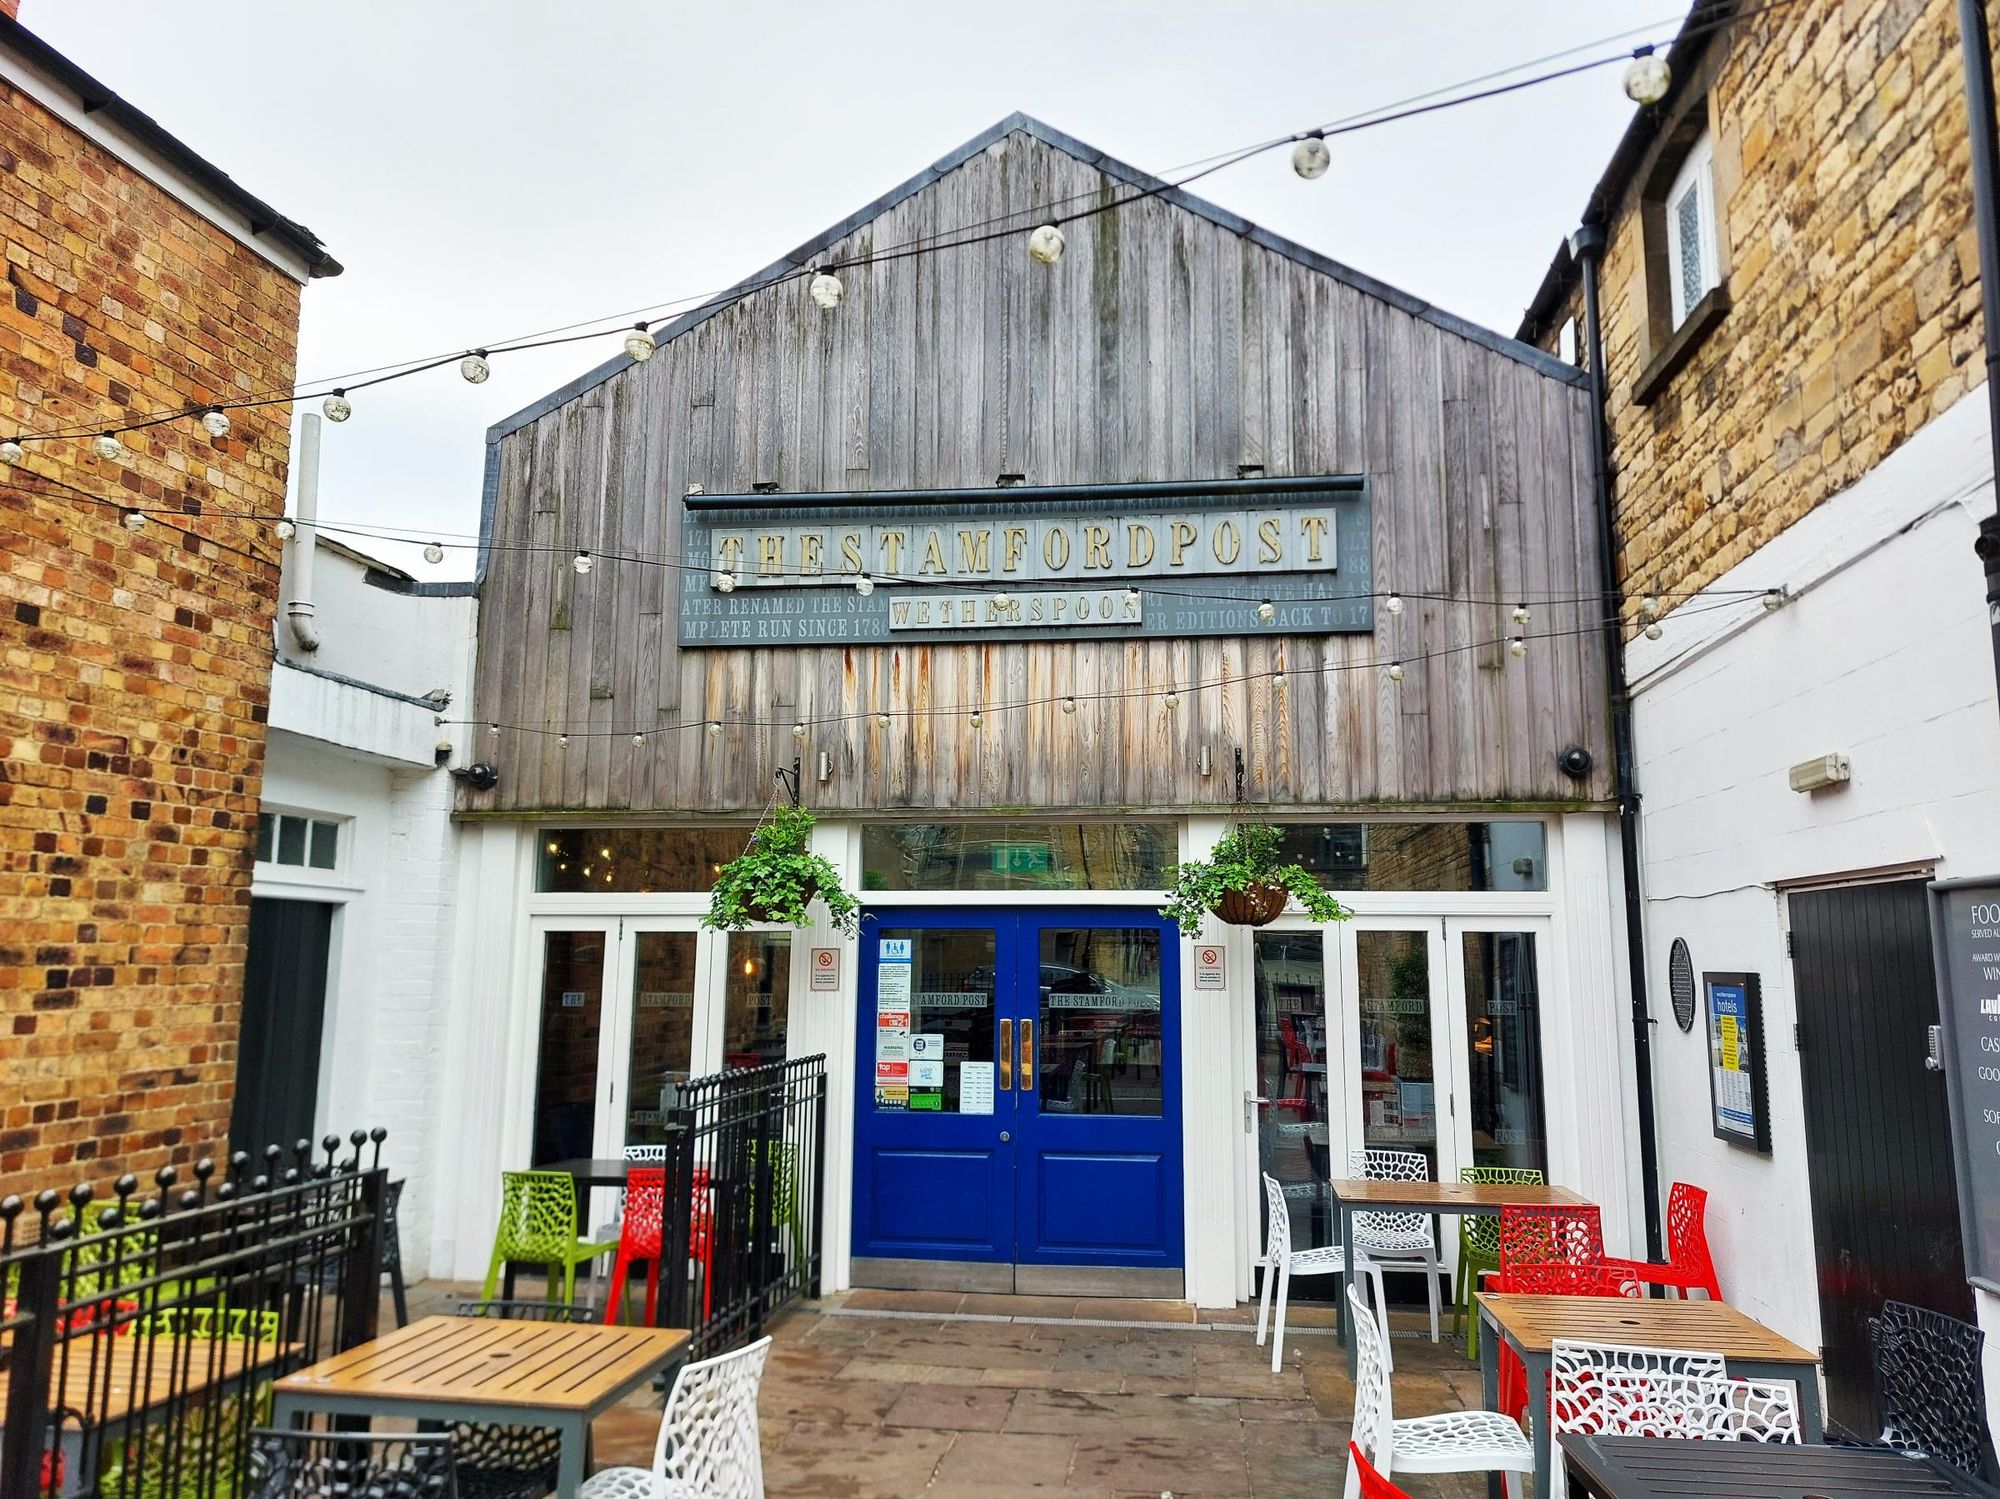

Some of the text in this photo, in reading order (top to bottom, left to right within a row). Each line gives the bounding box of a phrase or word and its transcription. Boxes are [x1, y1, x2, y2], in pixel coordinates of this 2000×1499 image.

[681, 599, 722, 616] ATER
[729, 597, 805, 615] RENAMED
[811, 597, 841, 614] THE
[891, 595, 1136, 624] WETHERSPOON
[1176, 609, 1258, 631] EDITIONS
[1321, 606, 1342, 625] TO
[684, 621, 751, 638] MPLETE
[757, 619, 792, 637] RUN
[798, 618, 847, 637] SINCE
[1972, 929, 1992, 939] SERVED
[749, 994, 771, 1005] POST
[963, 994, 986, 1006] POST
[1050, 995, 1070, 1006] THE
[1073, 995, 1124, 1007] STAMFORD
[1717, 998, 1737, 1013] hotels
